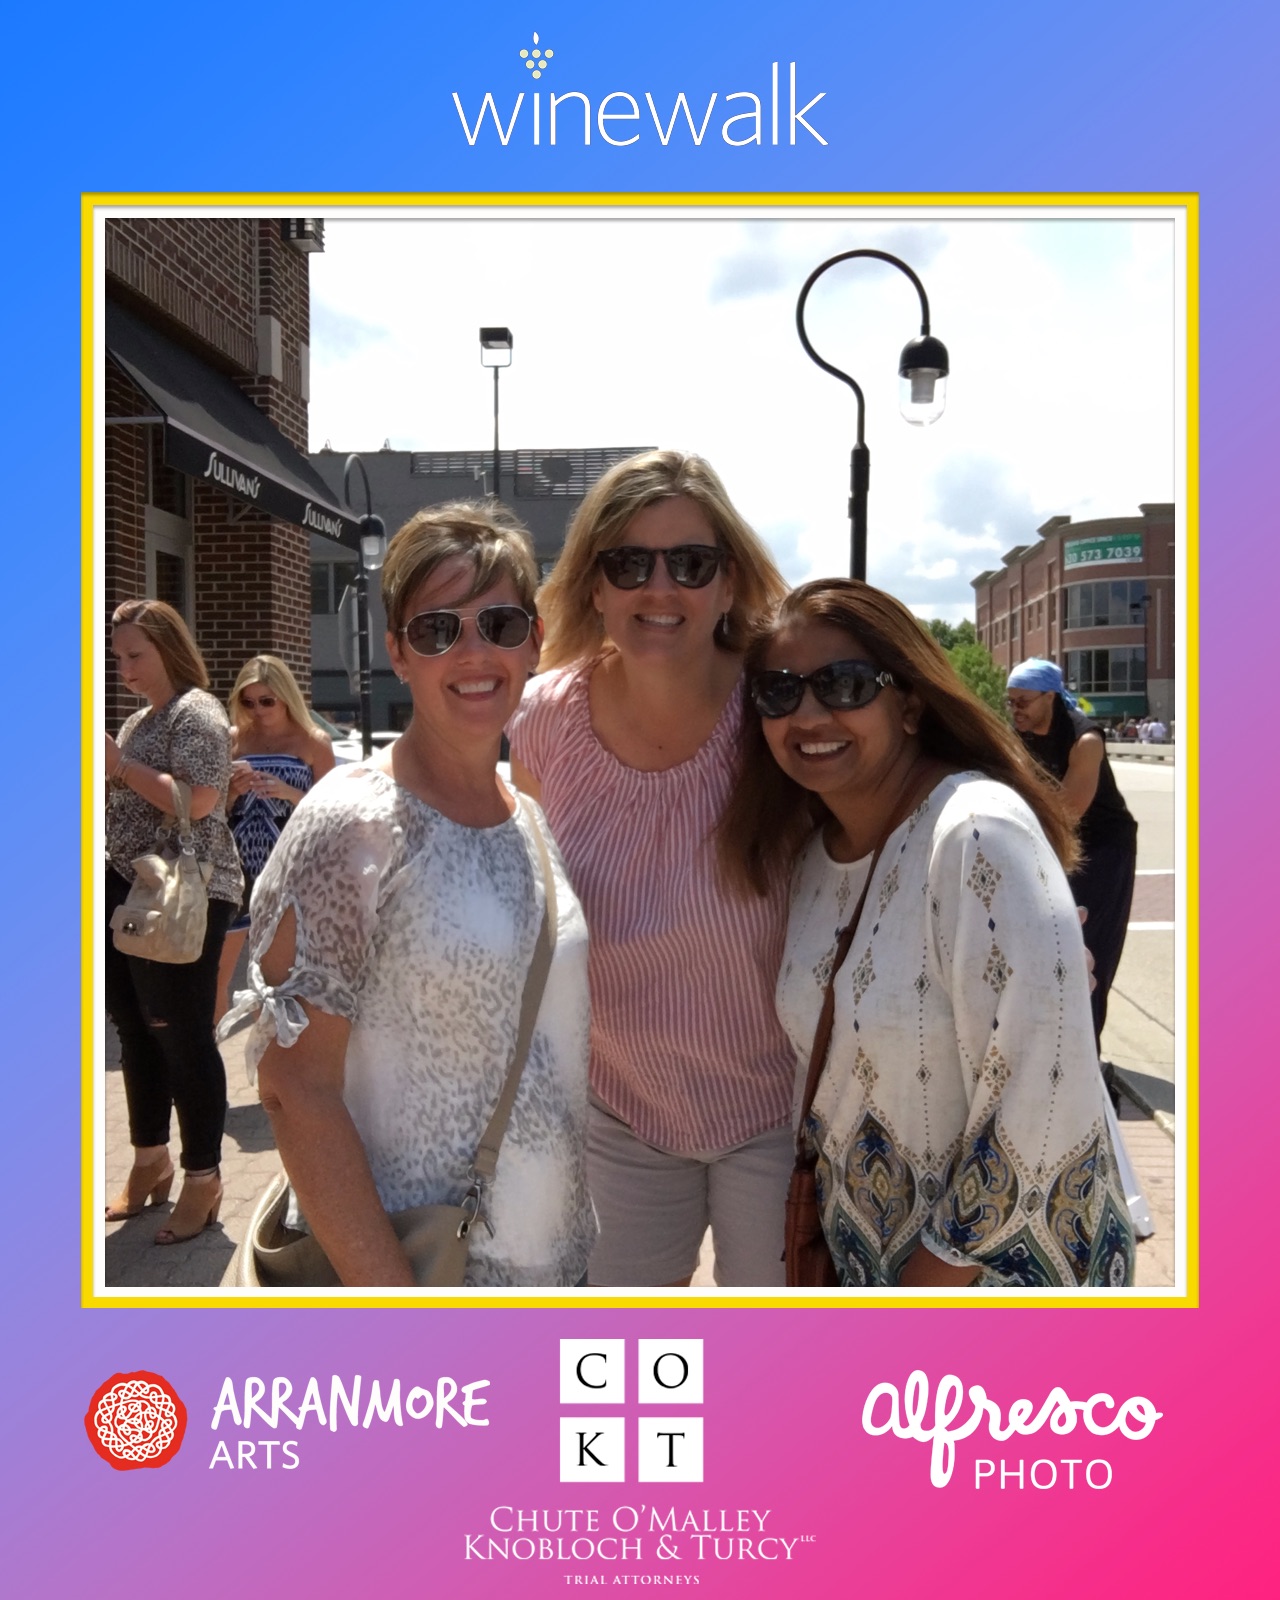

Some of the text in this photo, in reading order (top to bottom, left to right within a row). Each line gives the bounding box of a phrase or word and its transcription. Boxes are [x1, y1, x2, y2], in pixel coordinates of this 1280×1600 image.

[204, 452, 261, 499] SULLIVAN'S
[302, 502, 343, 538] SULLIVAN'S
[1081, 548, 1101, 562] 573
[1106, 546, 1141, 559] 7039
